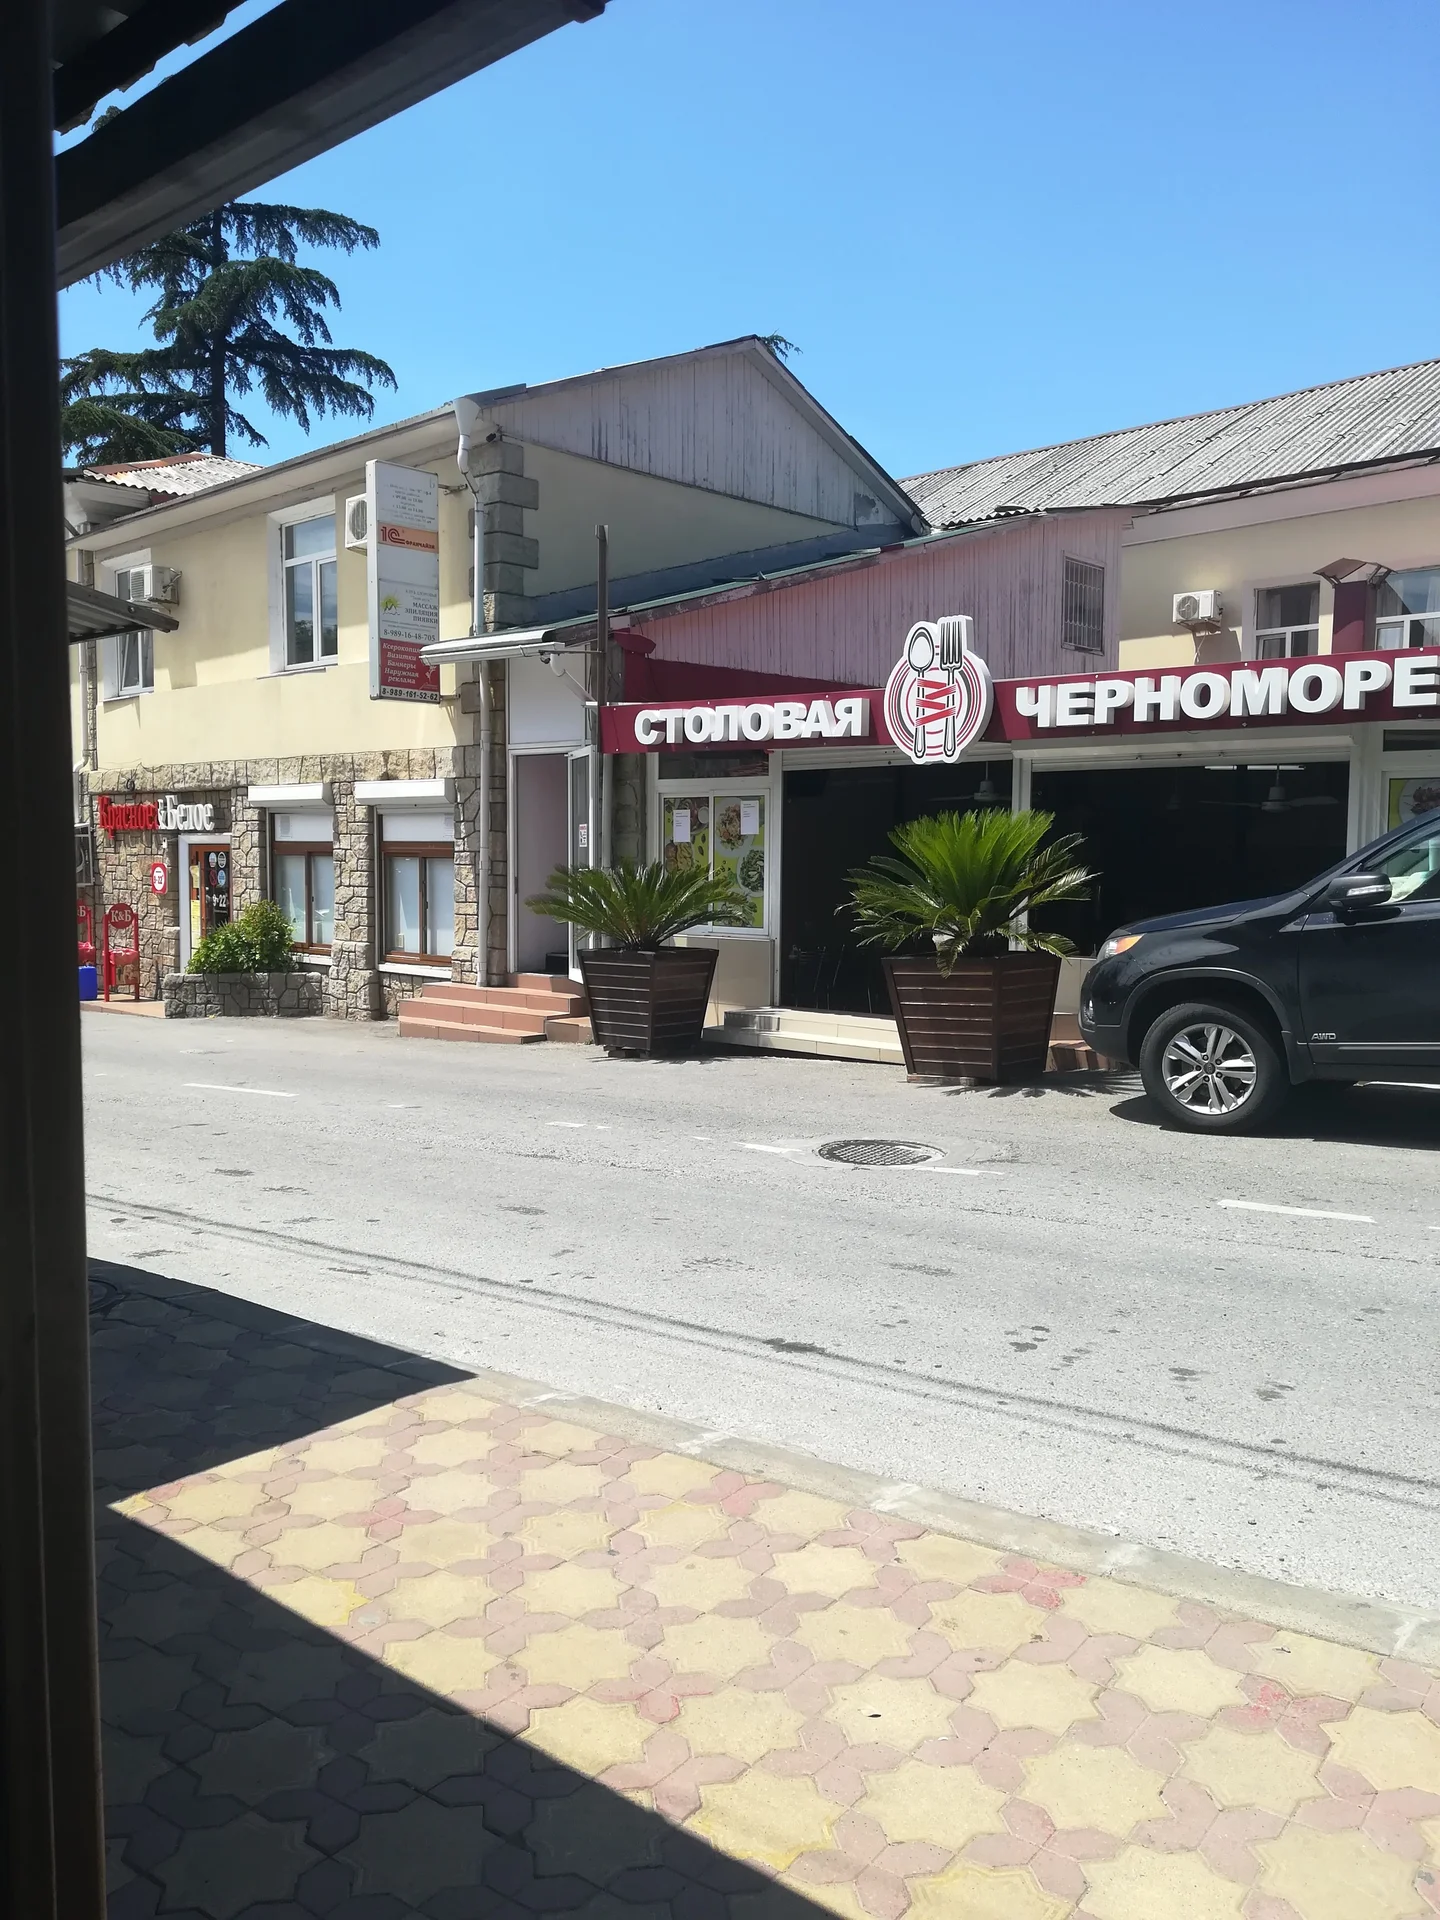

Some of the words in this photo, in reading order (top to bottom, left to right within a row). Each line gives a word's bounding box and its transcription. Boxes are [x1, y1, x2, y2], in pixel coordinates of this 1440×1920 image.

[412, 601, 438, 611] МАССАЖ
[404, 607, 438, 618] ЭПИЛЯЦИЯ
[412, 615, 438, 625] ПИЯВКИ
[383, 628, 436, 642] 8-989-16-48-705
[387, 651, 417, 661] Визитки
[387, 659, 417, 670] Баннеры
[384, 667, 420, 678] Наружная
[387, 676, 416, 685] реклама
[381, 687, 438, 701] 8-989-161-52-62
[1015, 654, 1440, 728] ЧЕРНОМОРЕ
[634, 697, 870, 745] СТОЛОВАЯ
[1310, 1032, 1337, 1041] AWD
